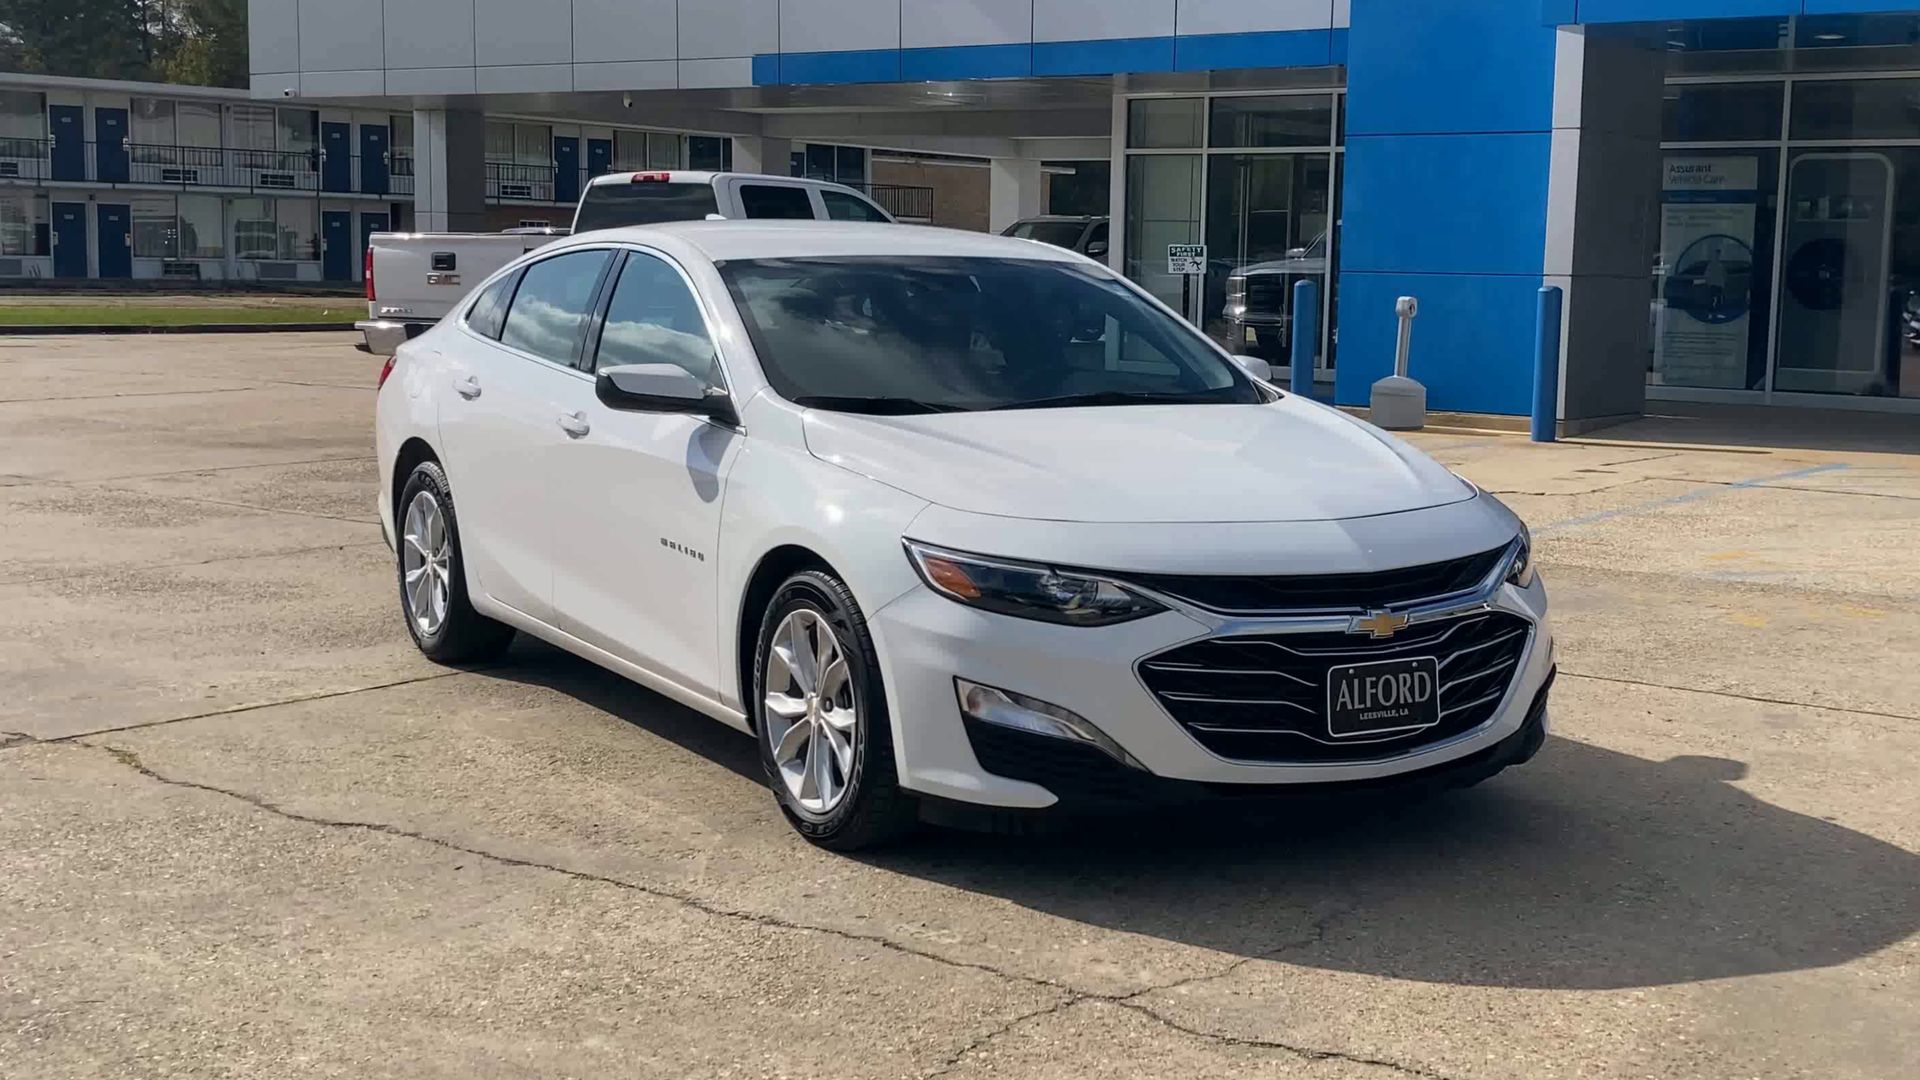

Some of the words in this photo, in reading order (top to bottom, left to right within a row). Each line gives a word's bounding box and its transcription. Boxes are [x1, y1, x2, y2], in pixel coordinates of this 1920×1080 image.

[1669, 164, 1711, 173] Assurant
[426, 272, 461, 286] GMC
[1336, 671, 1432, 712] ALFORD
[1359, 709, 1399, 721] LEESVILLE,
[1399, 708, 1409, 716] LA
